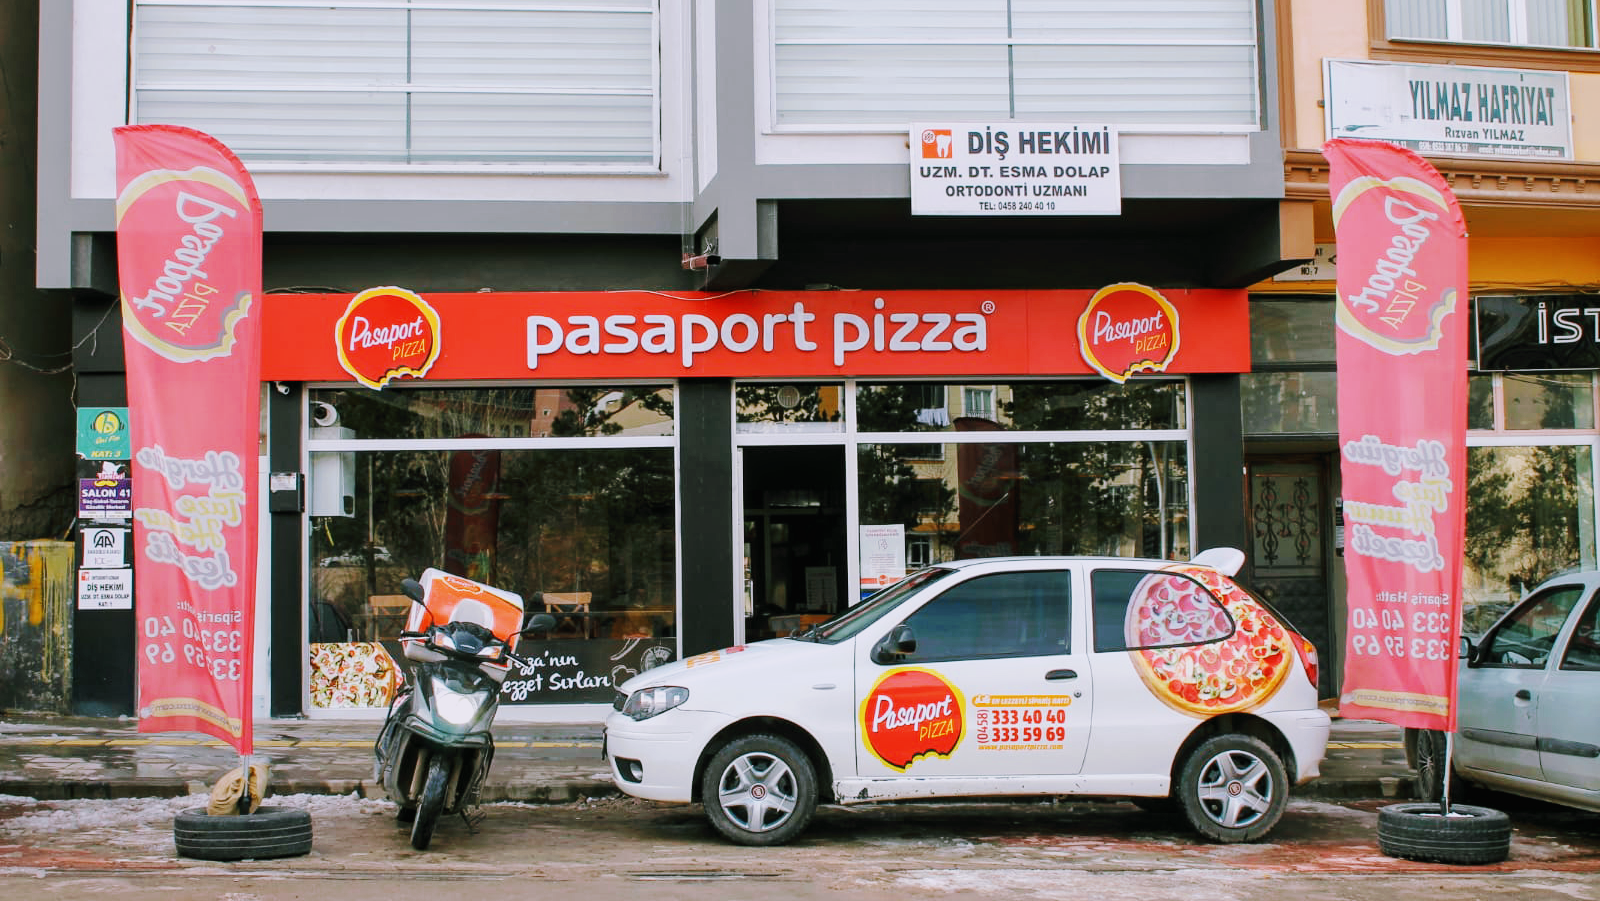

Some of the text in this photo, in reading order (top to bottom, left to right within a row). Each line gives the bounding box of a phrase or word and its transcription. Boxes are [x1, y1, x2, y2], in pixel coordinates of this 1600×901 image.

[1409, 73, 1555, 127] YILMAZ HAFRİYAT
[968, 126, 1110, 160] DİŞ HEKİMİ
[1482, 128, 1525, 142] YILMAZ
[920, 166, 1110, 178] UZM. DT. ESMA DOLAP
[945, 182, 1087, 197] ORTODONTİ UZMANI
[979, 202, 1056, 210] TEL: 0458 240 40 10
[349, 316, 424, 351] Pasaport
[527, 297, 987, 370] pasaport pizza
[1093, 310, 1163, 345] Pasaport
[393, 339, 426, 361] PIZZA
[1136, 332, 1167, 354] PIZZA
[81, 488, 131, 498] SALON 41
[87, 582, 124, 592] DİŞ HEKİMİ
[500, 671, 612, 701] ezzet Sırları
[872, 694, 953, 733] Pasaport
[992, 709, 1066, 725] 333 40 40
[919, 719, 954, 741] PIZZA
[977, 709, 990, 744] (0458)
[992, 727, 1066, 742] 333 59 69
